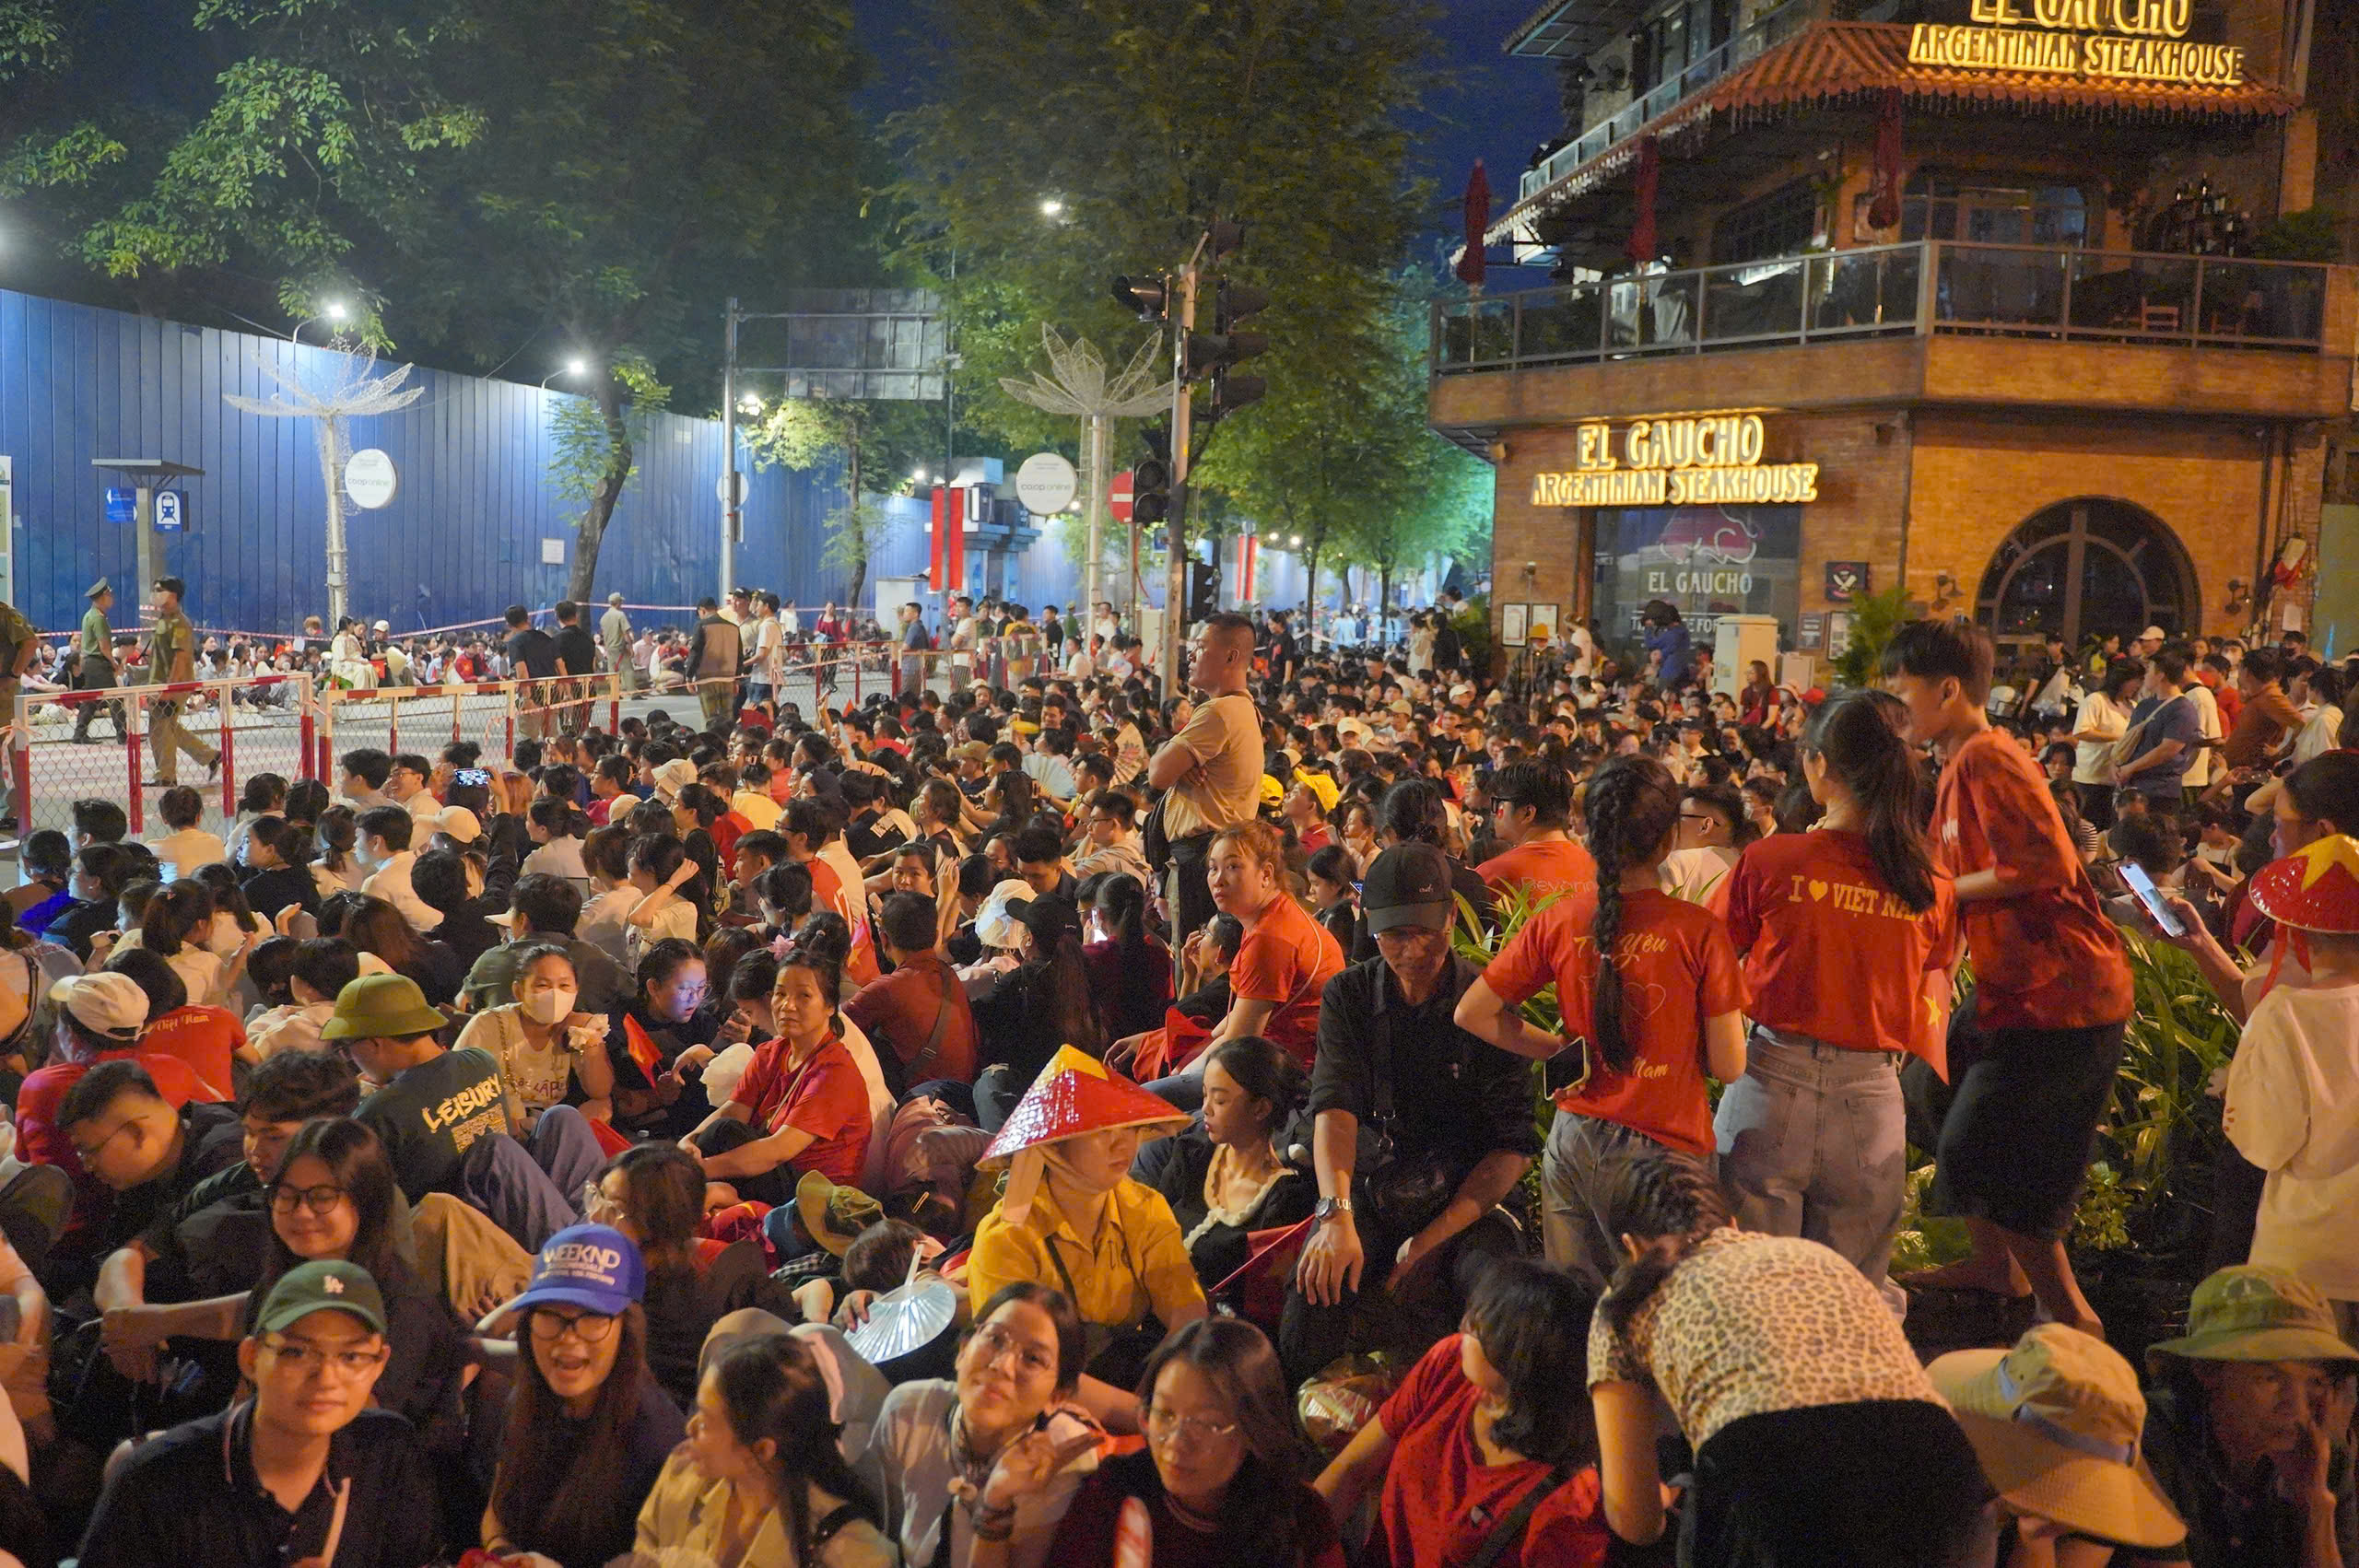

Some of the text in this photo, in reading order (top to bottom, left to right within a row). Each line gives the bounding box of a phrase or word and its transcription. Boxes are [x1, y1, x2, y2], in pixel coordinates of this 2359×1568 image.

[1907, 23, 2247, 87] ARGENTINIAN STEAKHOUSE
[1577, 415, 1765, 472] EL GAUCHO
[1530, 462, 1819, 506] ARGENTINIAN STEAKHOUSE
[1648, 571, 1753, 594] EL GAUCHO
[1788, 875, 1805, 903] I
[1833, 881, 1880, 919] VIỆT
[1631, 1056, 1670, 1080] Nam
[542, 1243, 622, 1273] WEEKND
